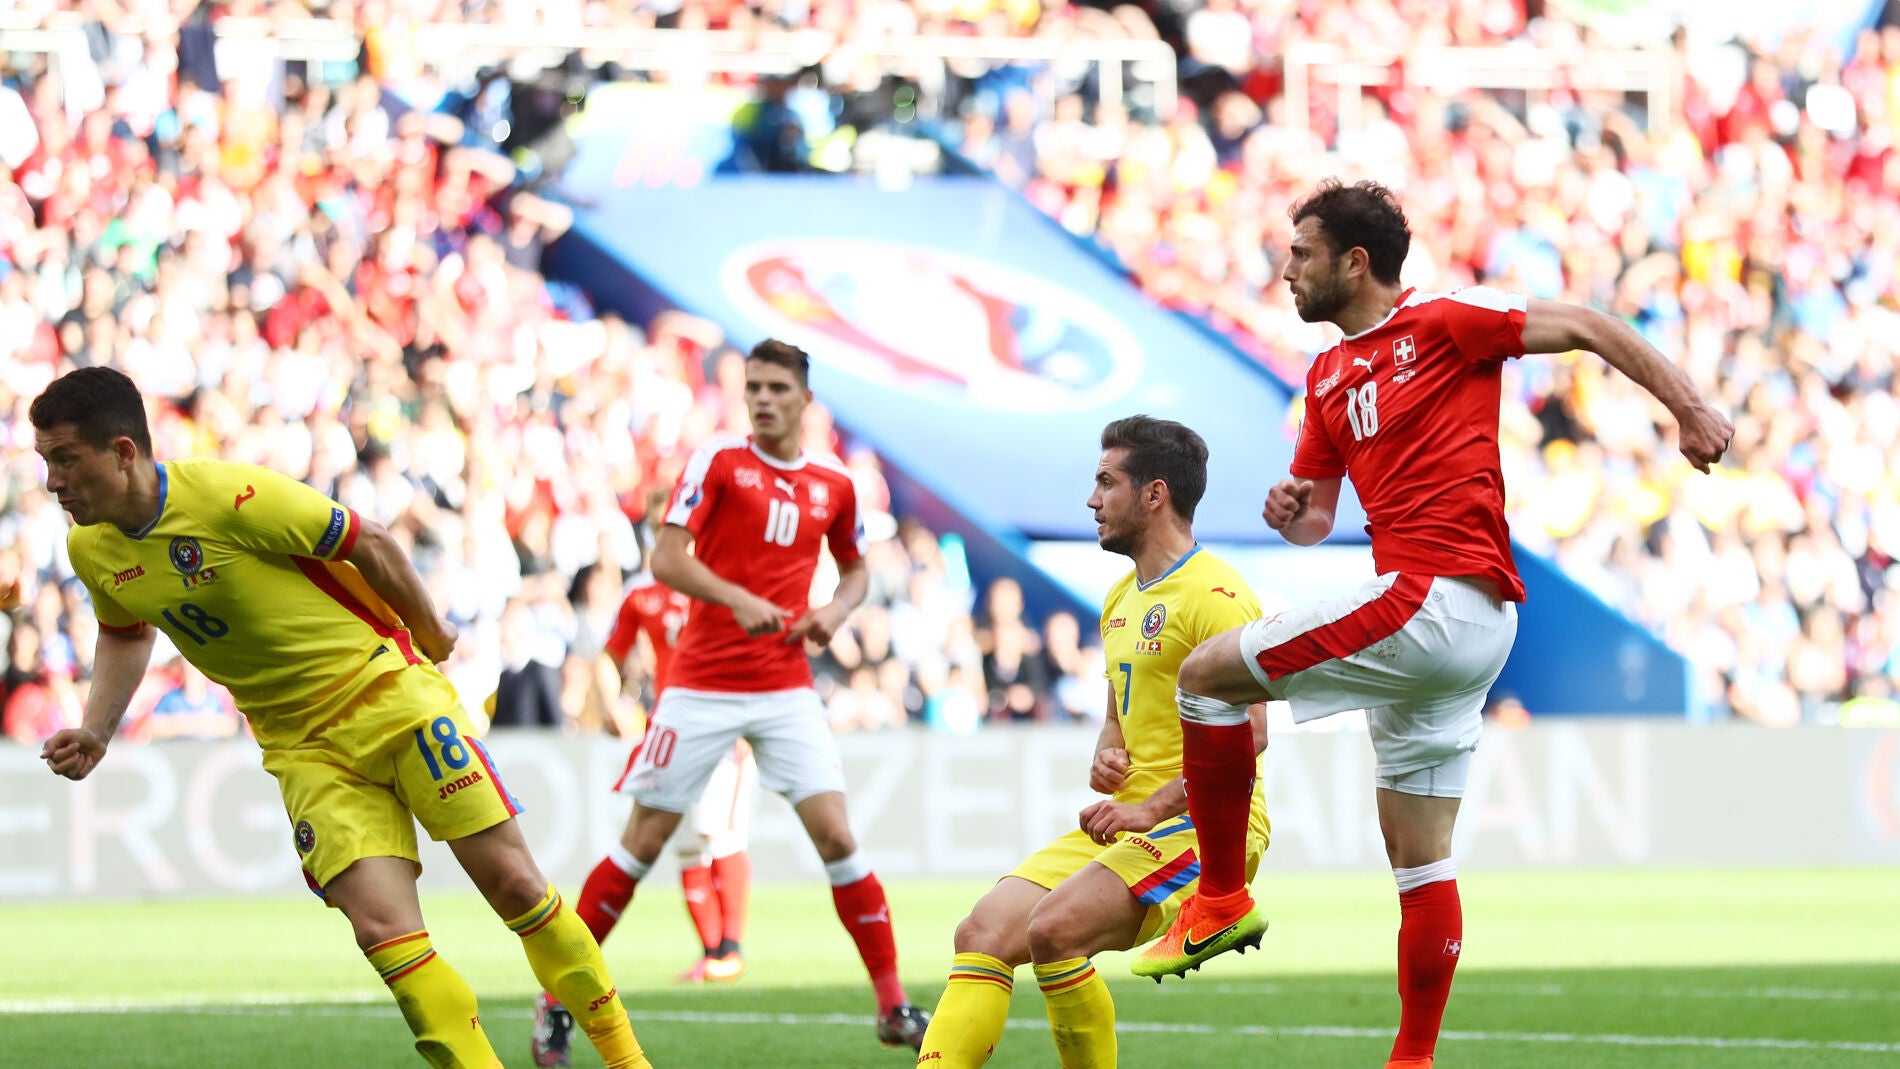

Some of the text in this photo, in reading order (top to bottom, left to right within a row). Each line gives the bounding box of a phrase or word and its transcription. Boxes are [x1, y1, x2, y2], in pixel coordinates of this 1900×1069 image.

[1346, 381, 1379, 442] 18
[323, 508, 342, 545] RESPECT
[764, 497, 800, 547] 10
[161, 603, 229, 646] 18
[1119, 662, 1132, 715] 7
[414, 716, 470, 781] 18
[645, 725, 677, 769] 10
